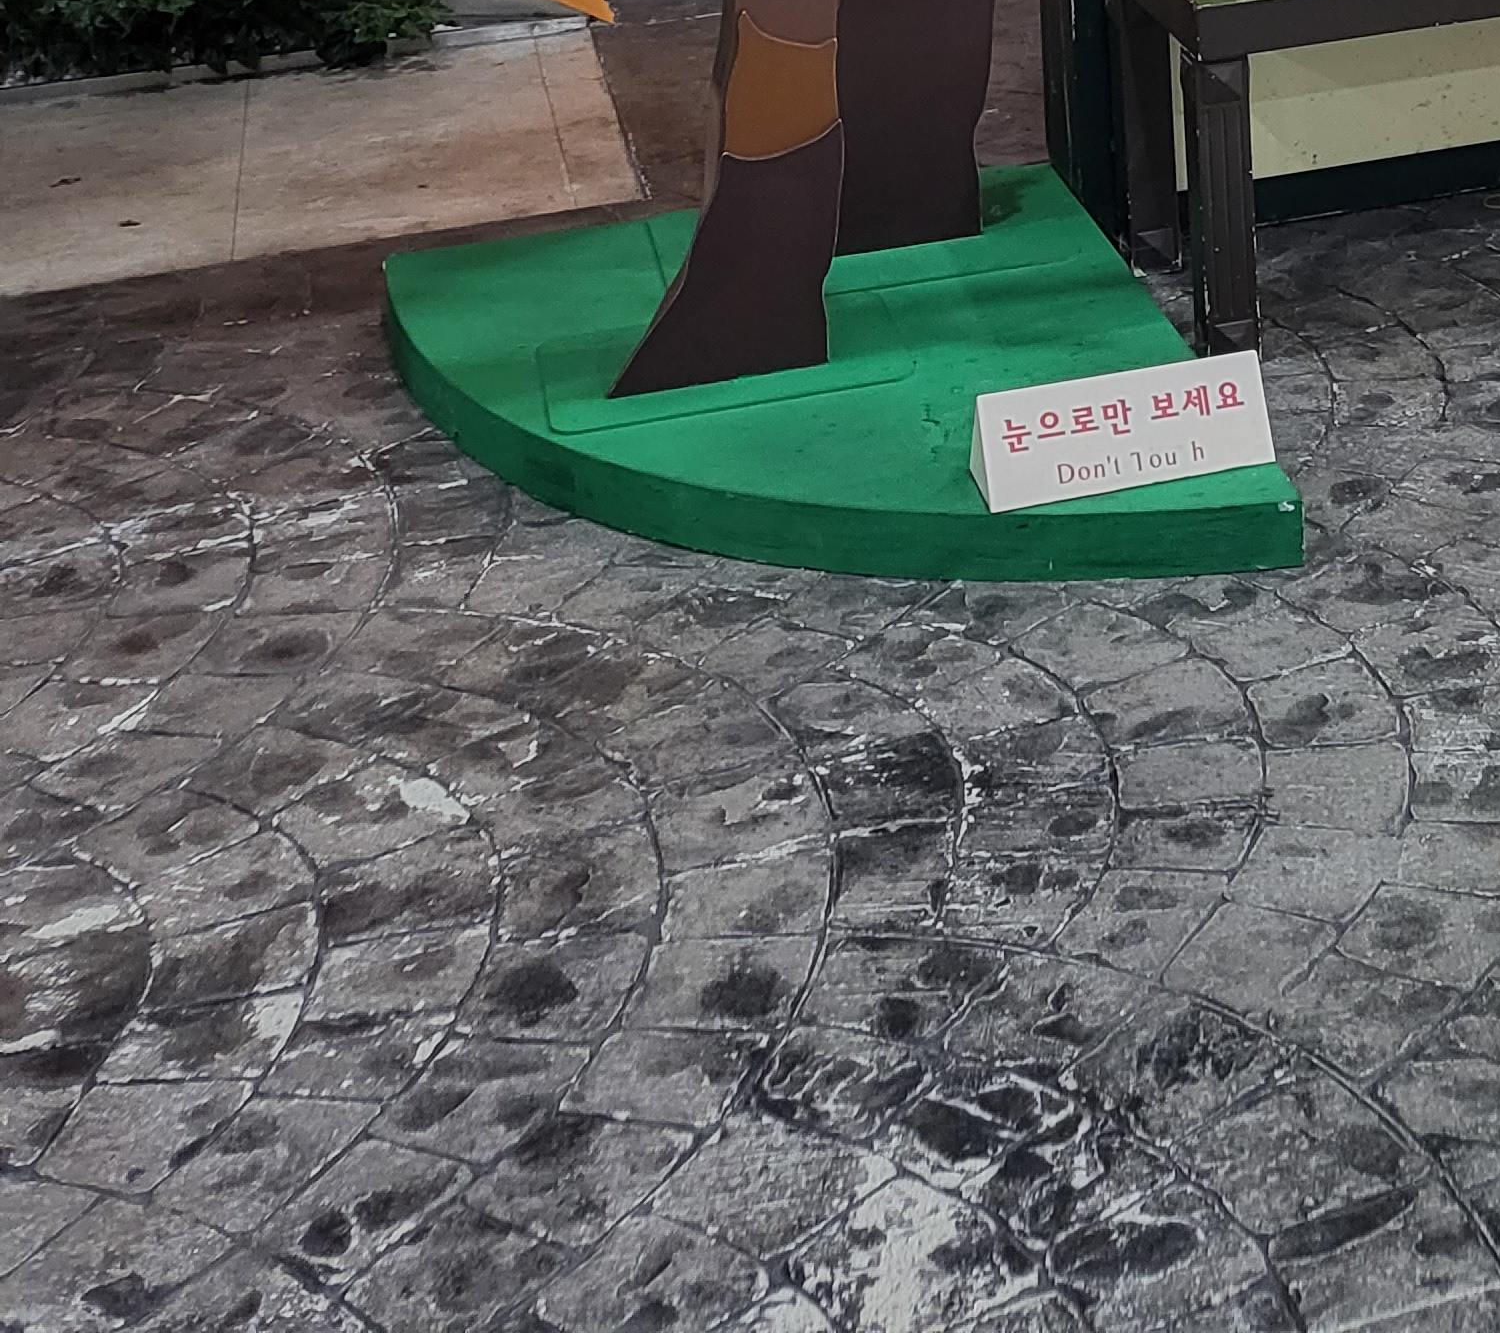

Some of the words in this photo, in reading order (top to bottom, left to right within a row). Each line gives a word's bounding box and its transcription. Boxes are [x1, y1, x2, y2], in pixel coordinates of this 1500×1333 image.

[1002, 398, 1132, 454] 눈으로만
[1150, 381, 1245, 421] 보세요
[1056, 454, 1121, 485] Don't
